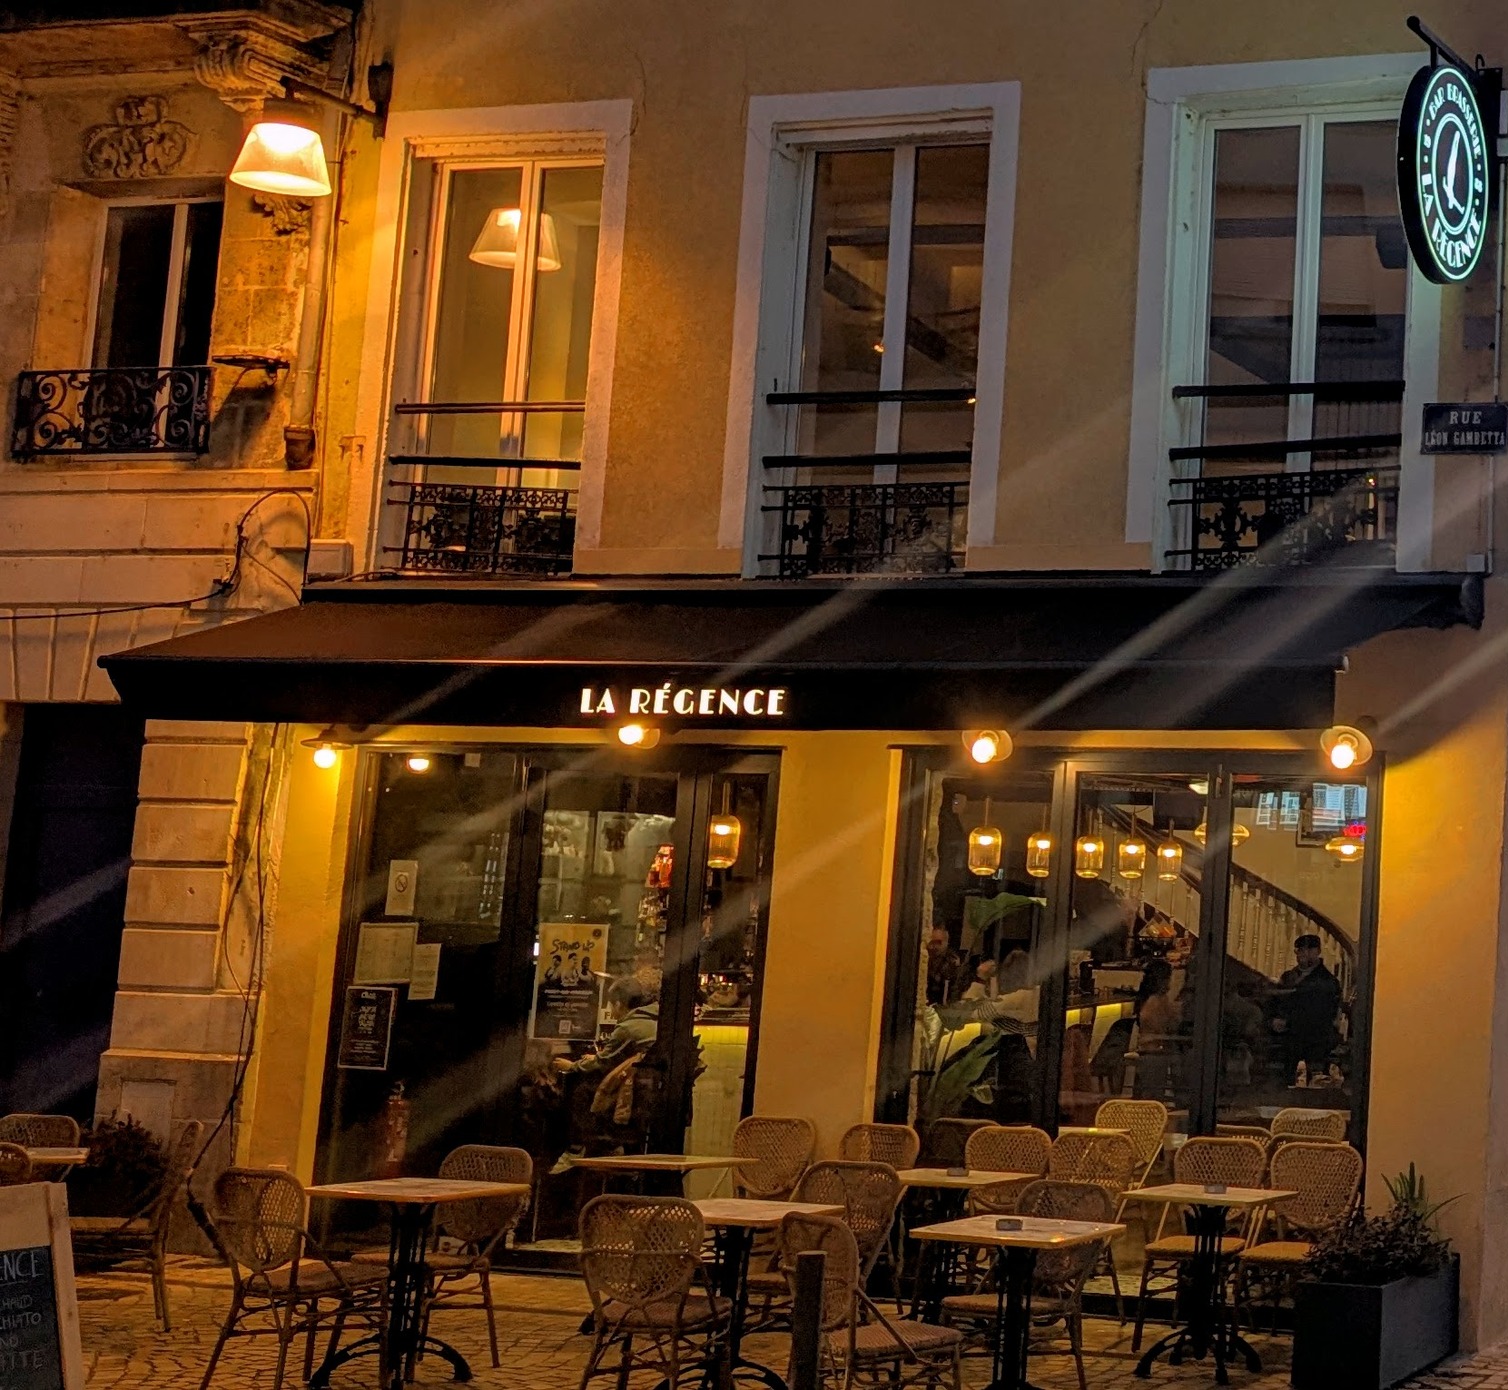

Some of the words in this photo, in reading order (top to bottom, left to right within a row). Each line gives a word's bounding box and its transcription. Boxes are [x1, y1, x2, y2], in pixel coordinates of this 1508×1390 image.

[1421, 173, 1434, 217] LA
[1449, 411, 1482, 425] RUE
[1454, 431, 1505, 446] GAMBETTA
[580, 688, 615, 714] LA
[629, 682, 785, 716] RÉGENCE
